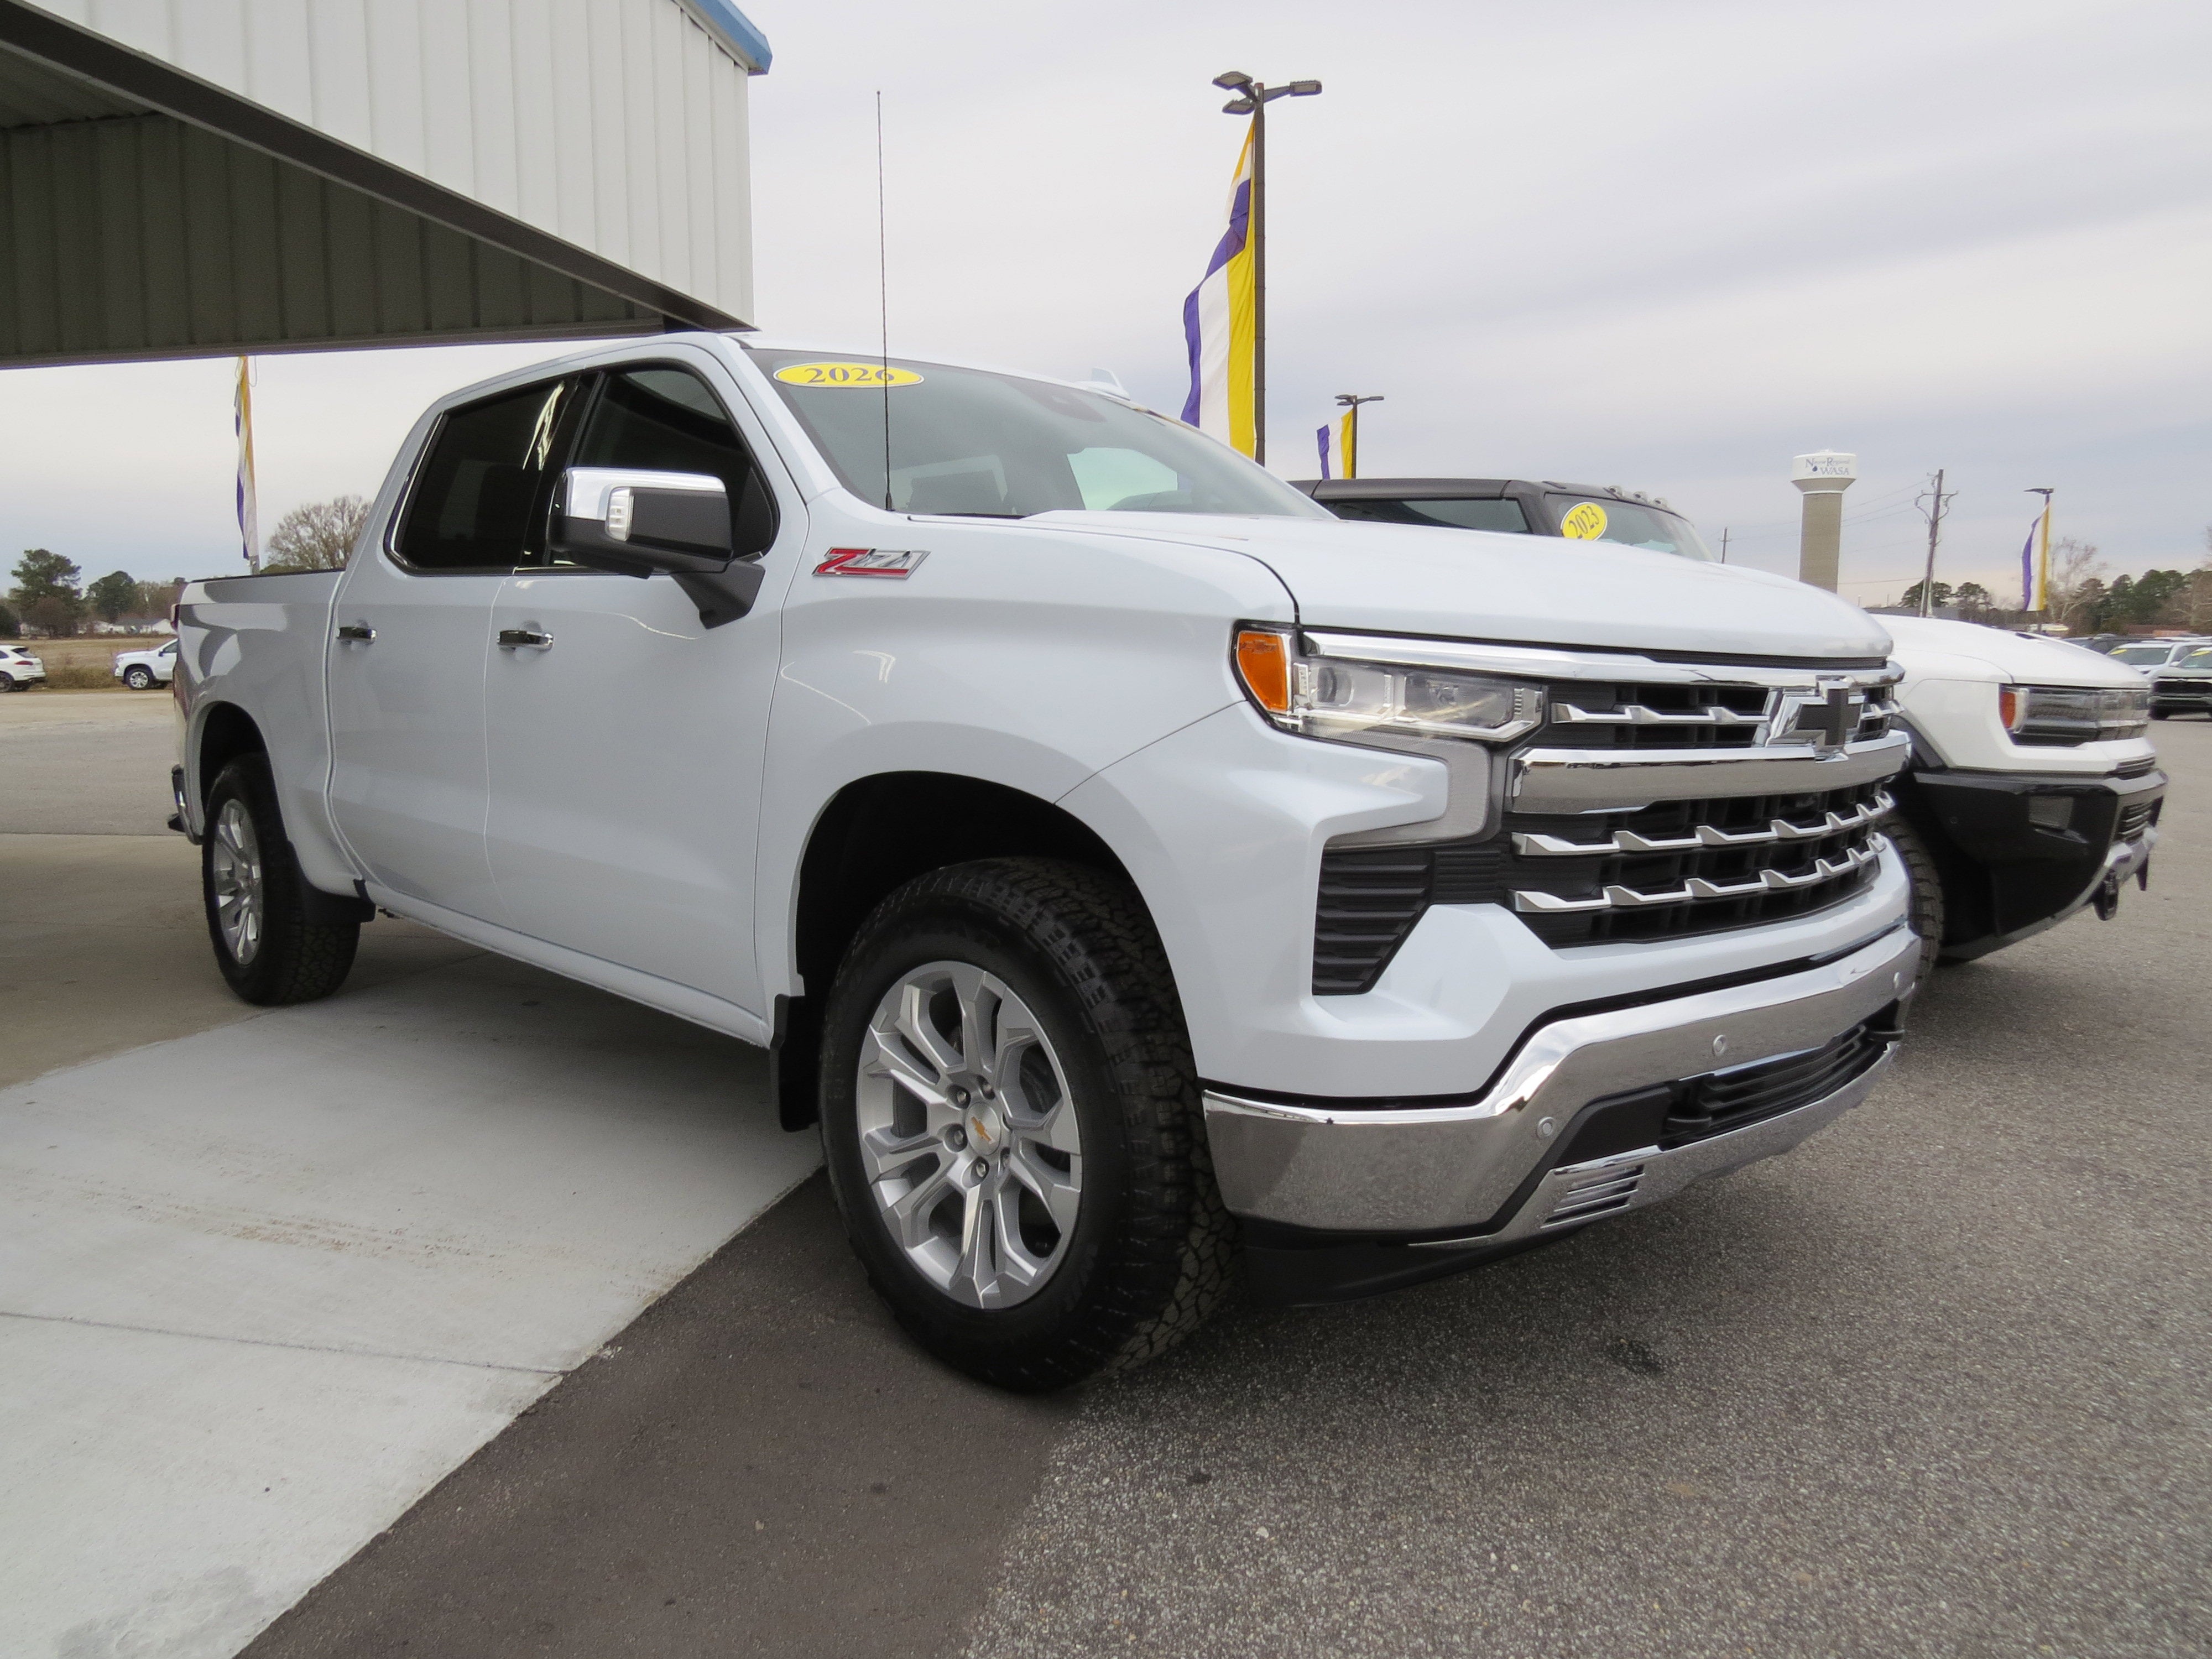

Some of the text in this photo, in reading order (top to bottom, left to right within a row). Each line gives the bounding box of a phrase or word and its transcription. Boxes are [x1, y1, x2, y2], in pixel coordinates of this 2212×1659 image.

[804, 367, 895, 384] 2026
[1819, 467, 1849, 476] WASA
[1568, 505, 1599, 539] 2023
[811, 546, 931, 580] Z71
